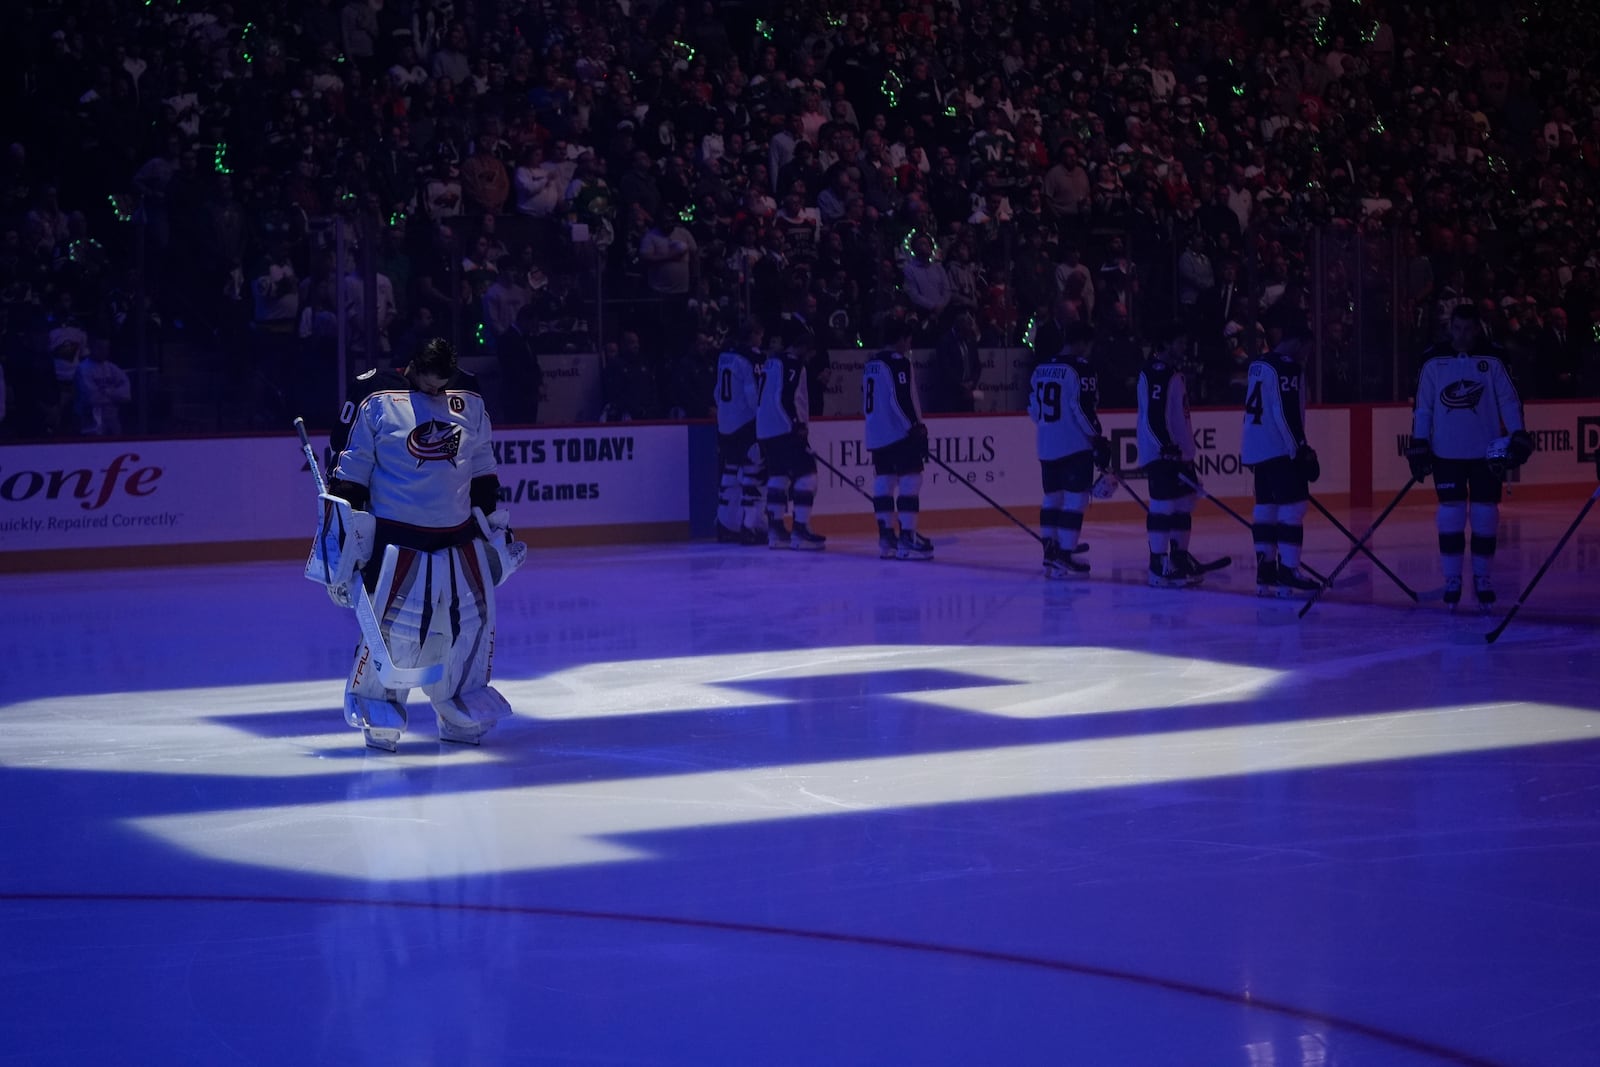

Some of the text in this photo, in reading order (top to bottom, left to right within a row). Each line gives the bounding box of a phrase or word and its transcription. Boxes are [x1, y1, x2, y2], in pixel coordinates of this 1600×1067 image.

[898, 371, 907, 384] 8
[1081, 376, 1097, 392] 59
[1280, 375, 1299, 392] 24
[1151, 384, 1162, 400] 2
[1243, 381, 1263, 425] 4
[491, 437, 634, 465] KETS TODAY!
[0, 453, 163, 510] onfe
[496, 479, 600, 503] m/Games
[0, 511, 178, 532] uickly. Repaired Correctly.
